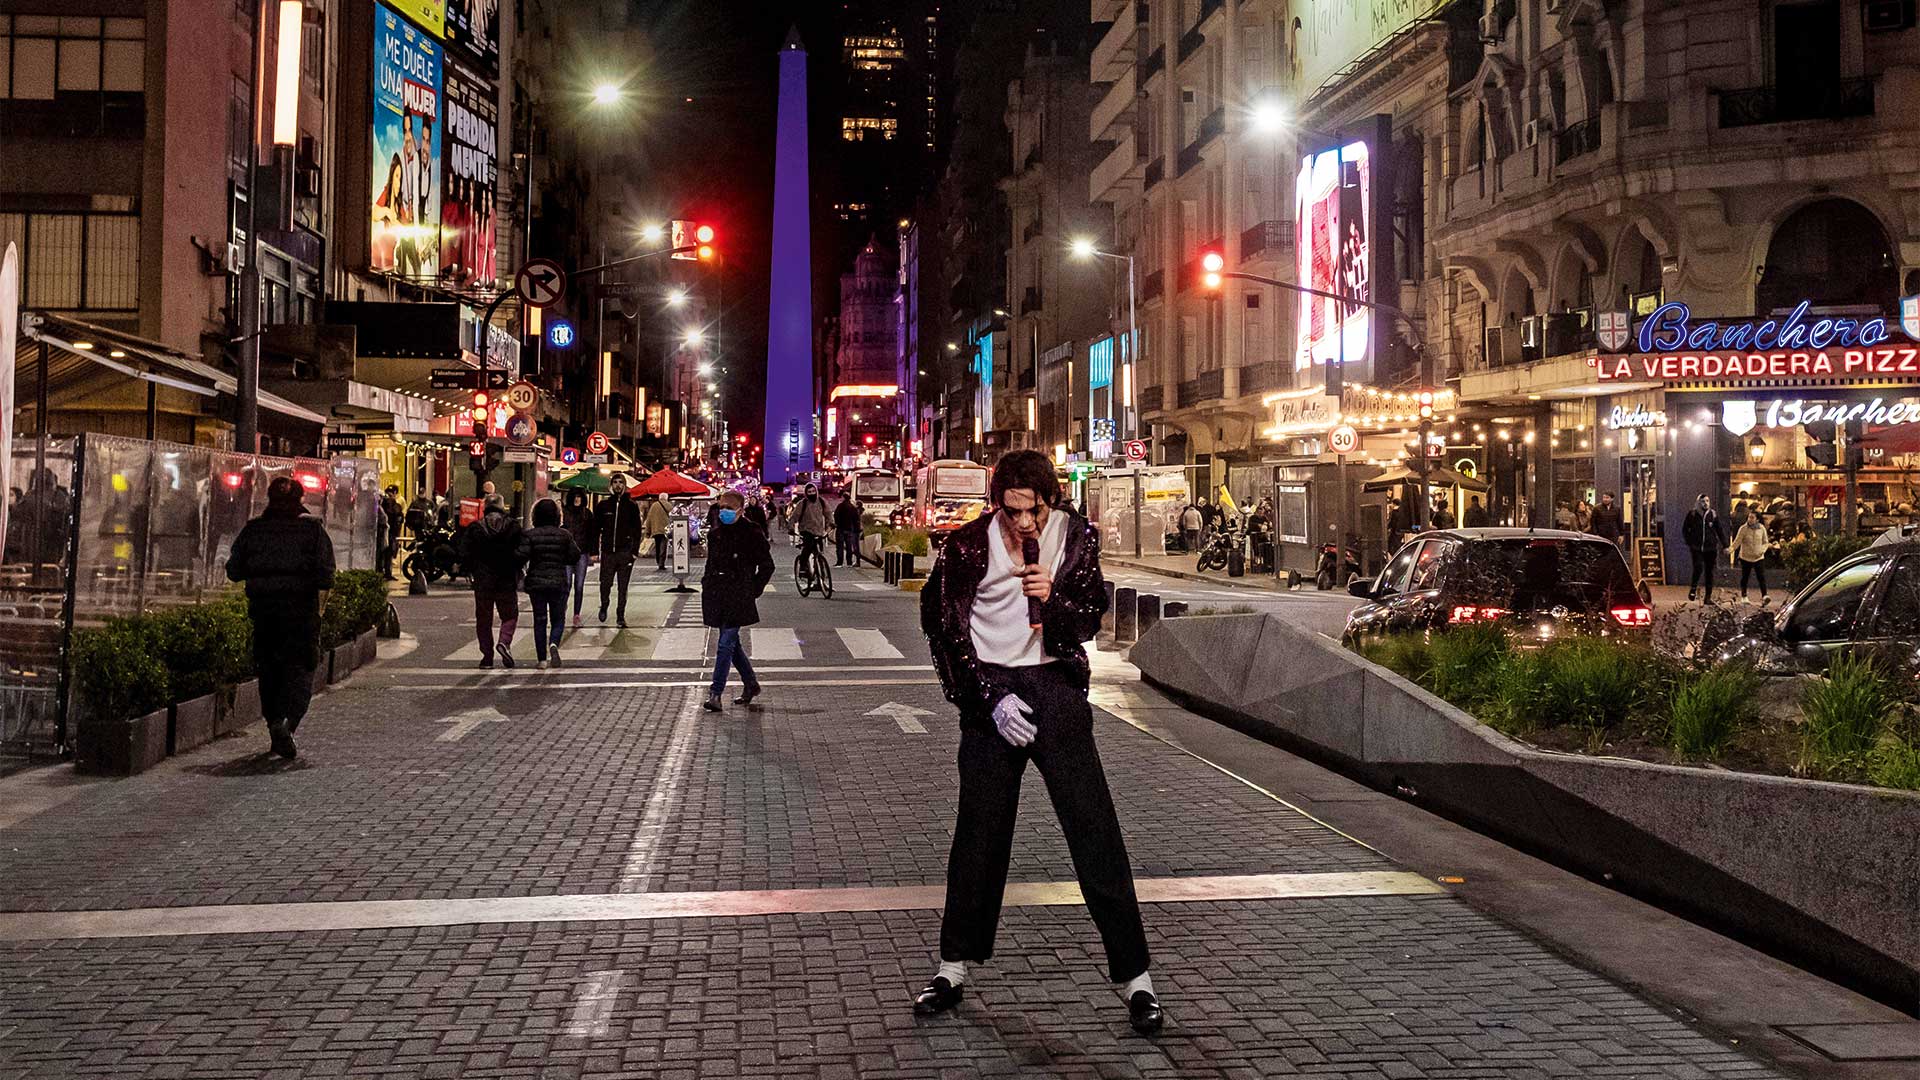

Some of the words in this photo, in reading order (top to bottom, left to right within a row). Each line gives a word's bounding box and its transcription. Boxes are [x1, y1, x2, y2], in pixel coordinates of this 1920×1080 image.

[385, 33, 400, 65] ME
[402, 45, 434, 87] DUELE
[380, 62, 403, 99] UNA
[404, 82, 436, 117] MUJER
[448, 99, 496, 159] PERDIDA
[451, 142, 488, 185] MENTE
[1639, 299, 1889, 353] Banchero
[1643, 352, 1833, 378] VERDADERA
[1844, 349, 1920, 373] PIZZ
[513, 390, 531, 403] 30
[1334, 433, 1352, 446] 30
